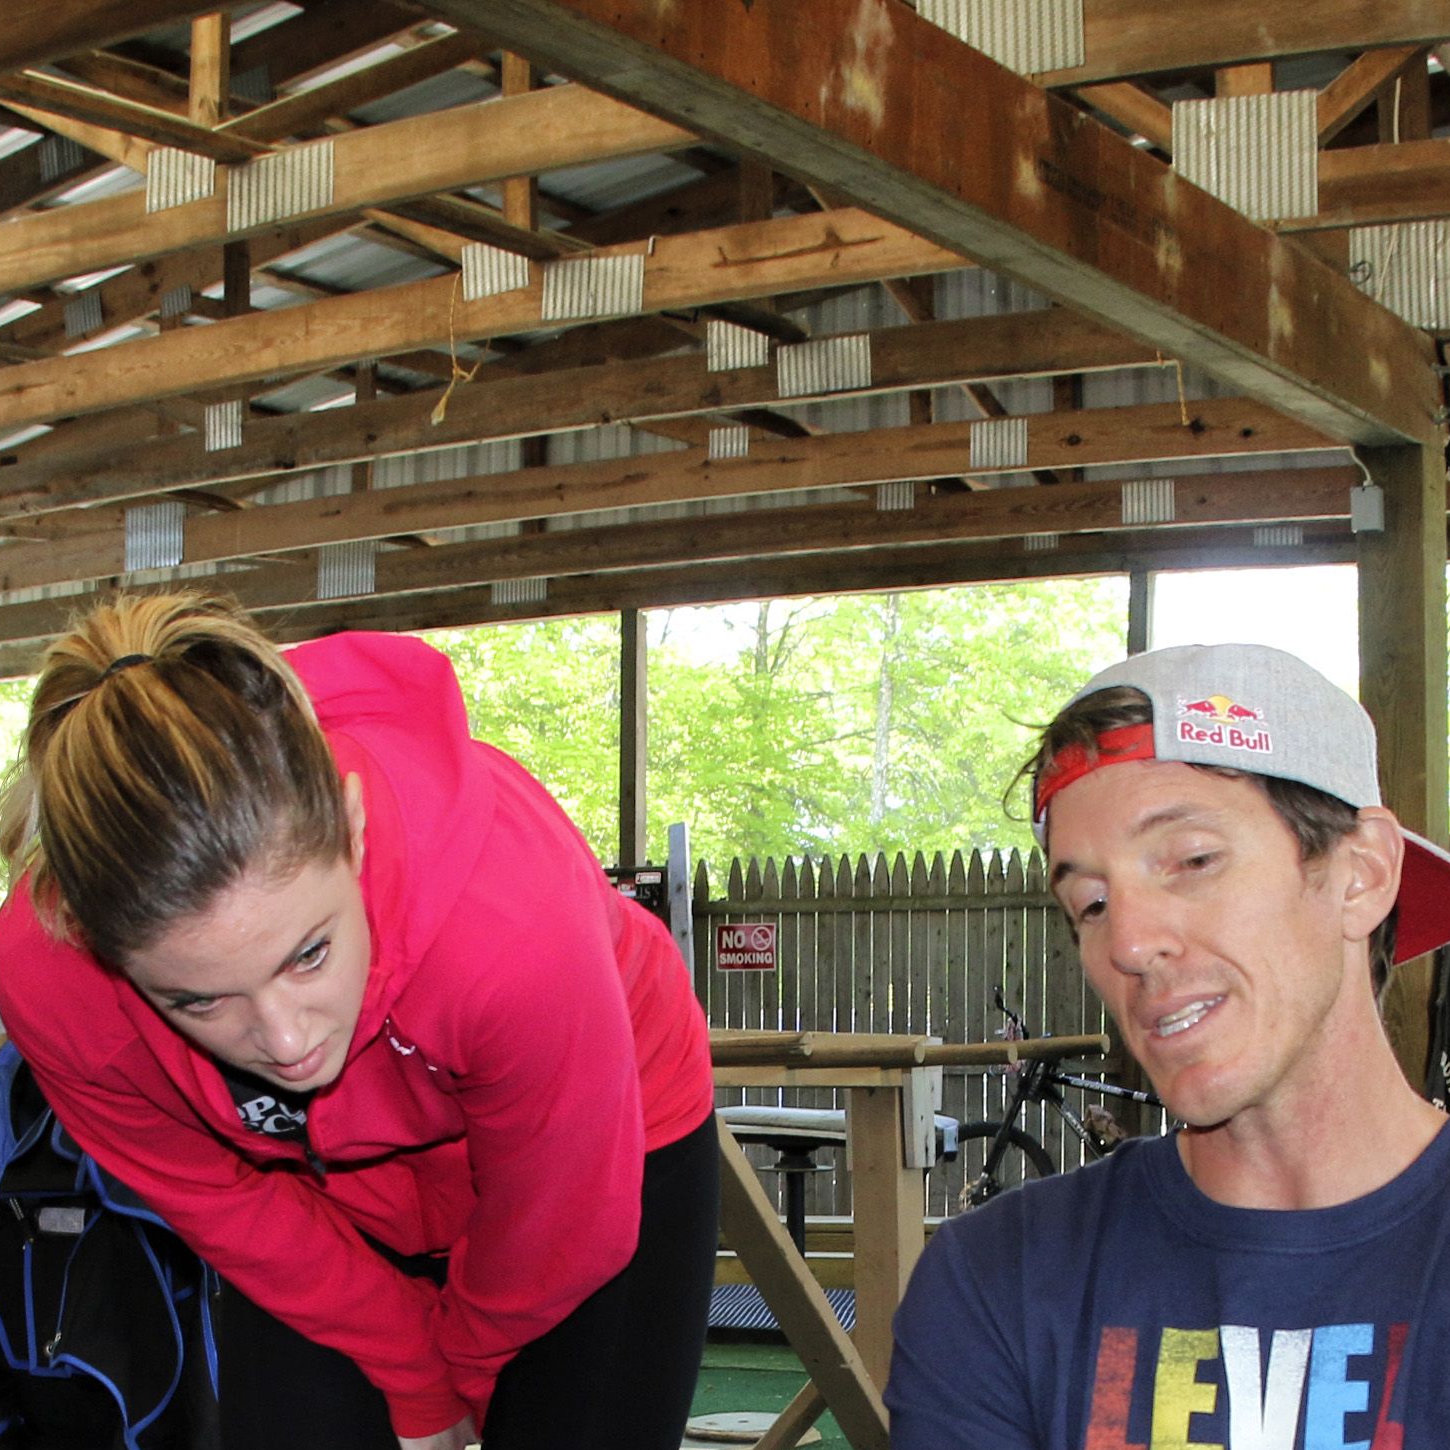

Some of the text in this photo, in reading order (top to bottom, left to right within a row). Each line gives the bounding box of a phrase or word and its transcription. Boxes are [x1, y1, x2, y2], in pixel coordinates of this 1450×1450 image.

[1180, 722, 1270, 751] Red Bull
[722, 931, 746, 949] NO
[720, 953, 772, 965] SMOKING
